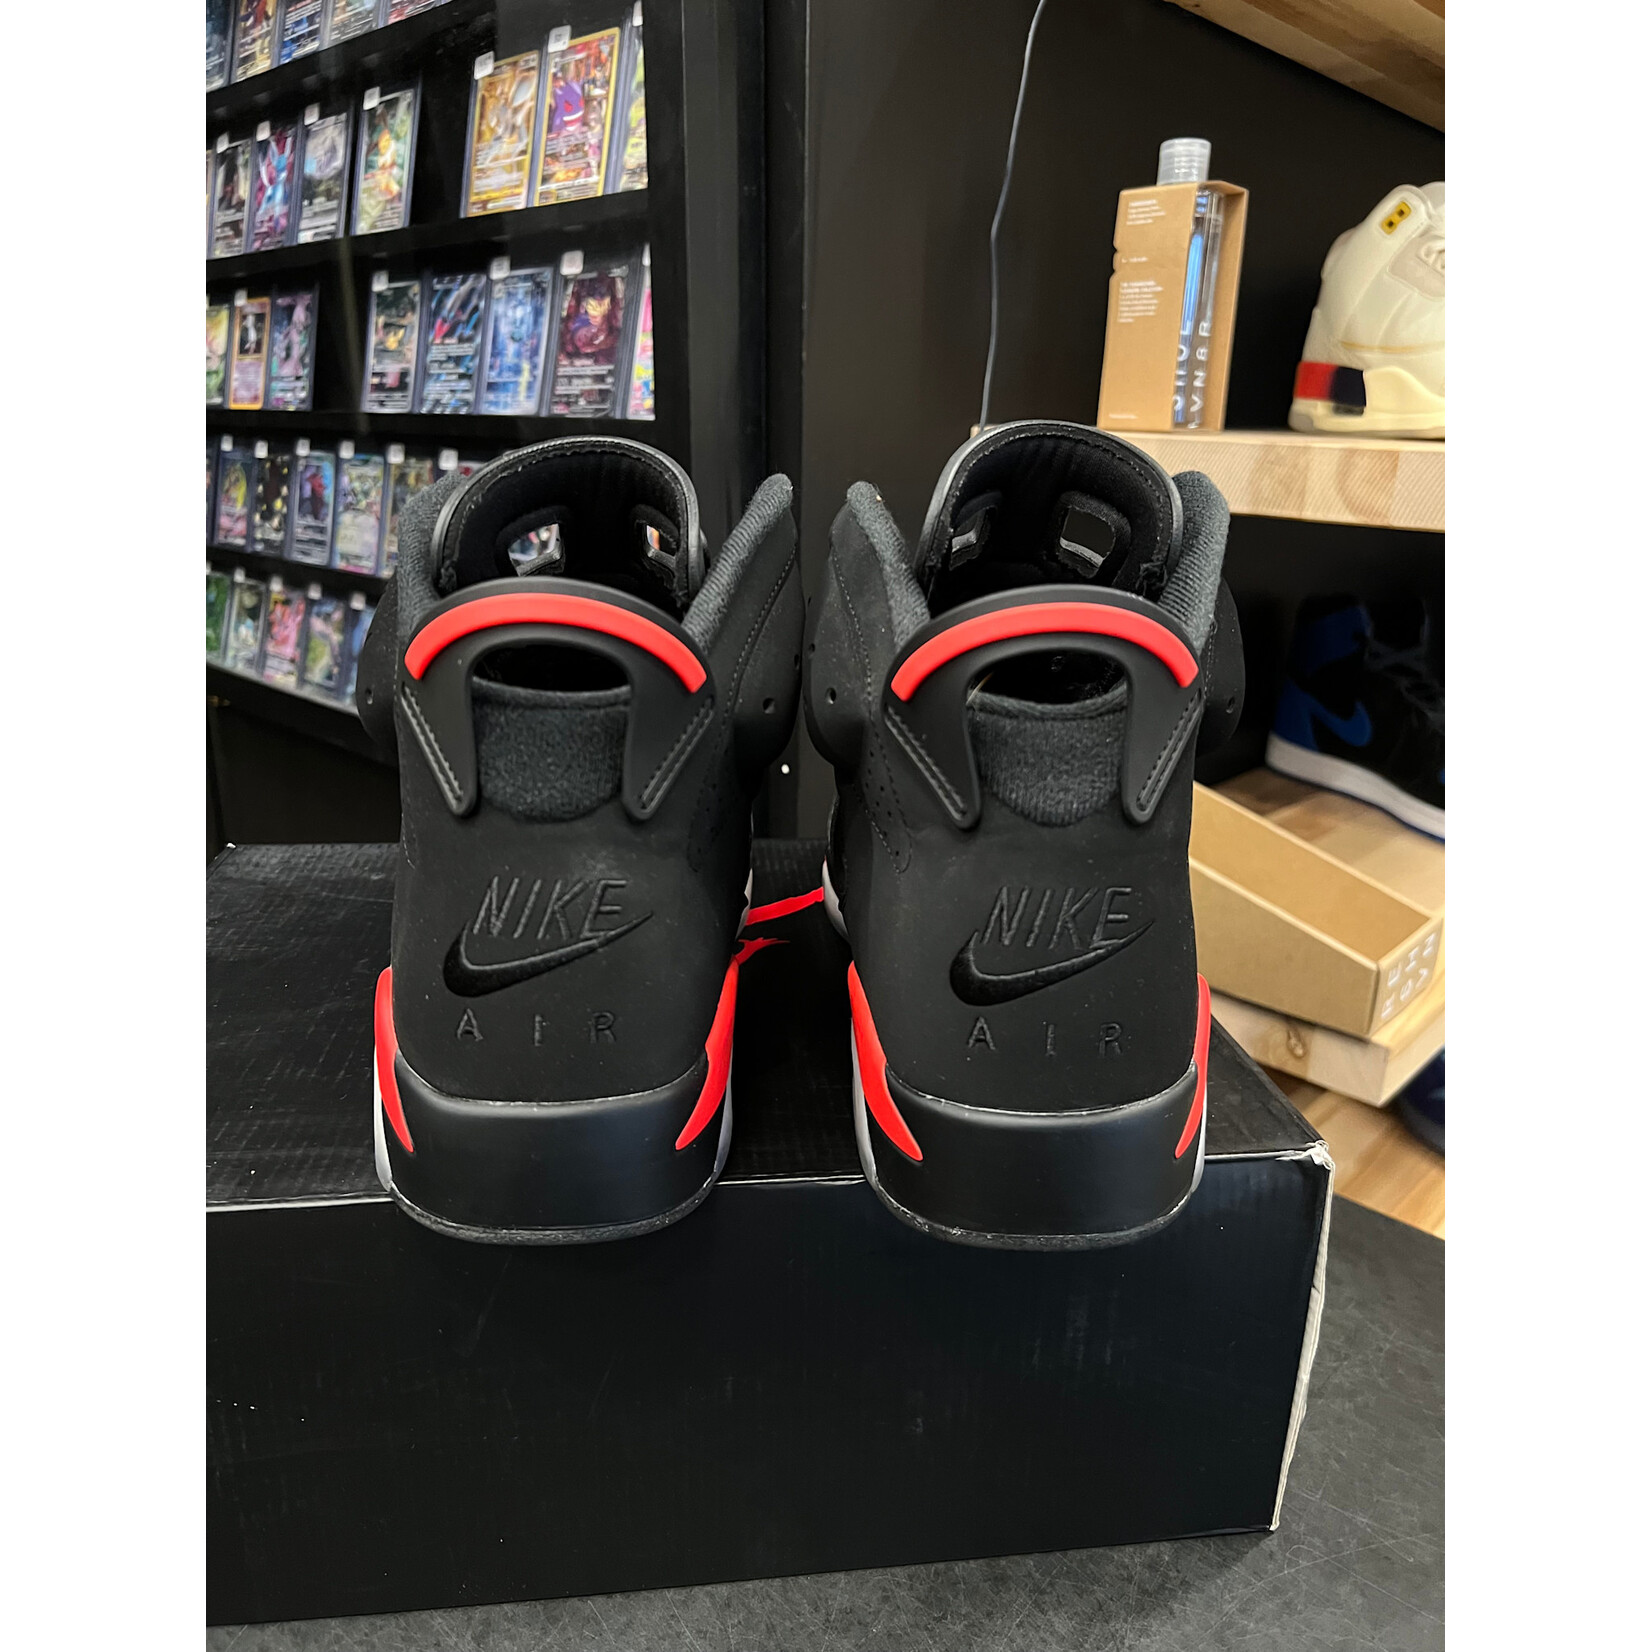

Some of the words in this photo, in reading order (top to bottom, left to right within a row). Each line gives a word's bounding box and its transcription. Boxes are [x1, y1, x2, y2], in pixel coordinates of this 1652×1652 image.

[473, 876, 628, 940] NIKE
[981, 886, 1133, 949] NIKE
[457, 1008, 616, 1047] AIR
[968, 1017, 1122, 1057] AIR
